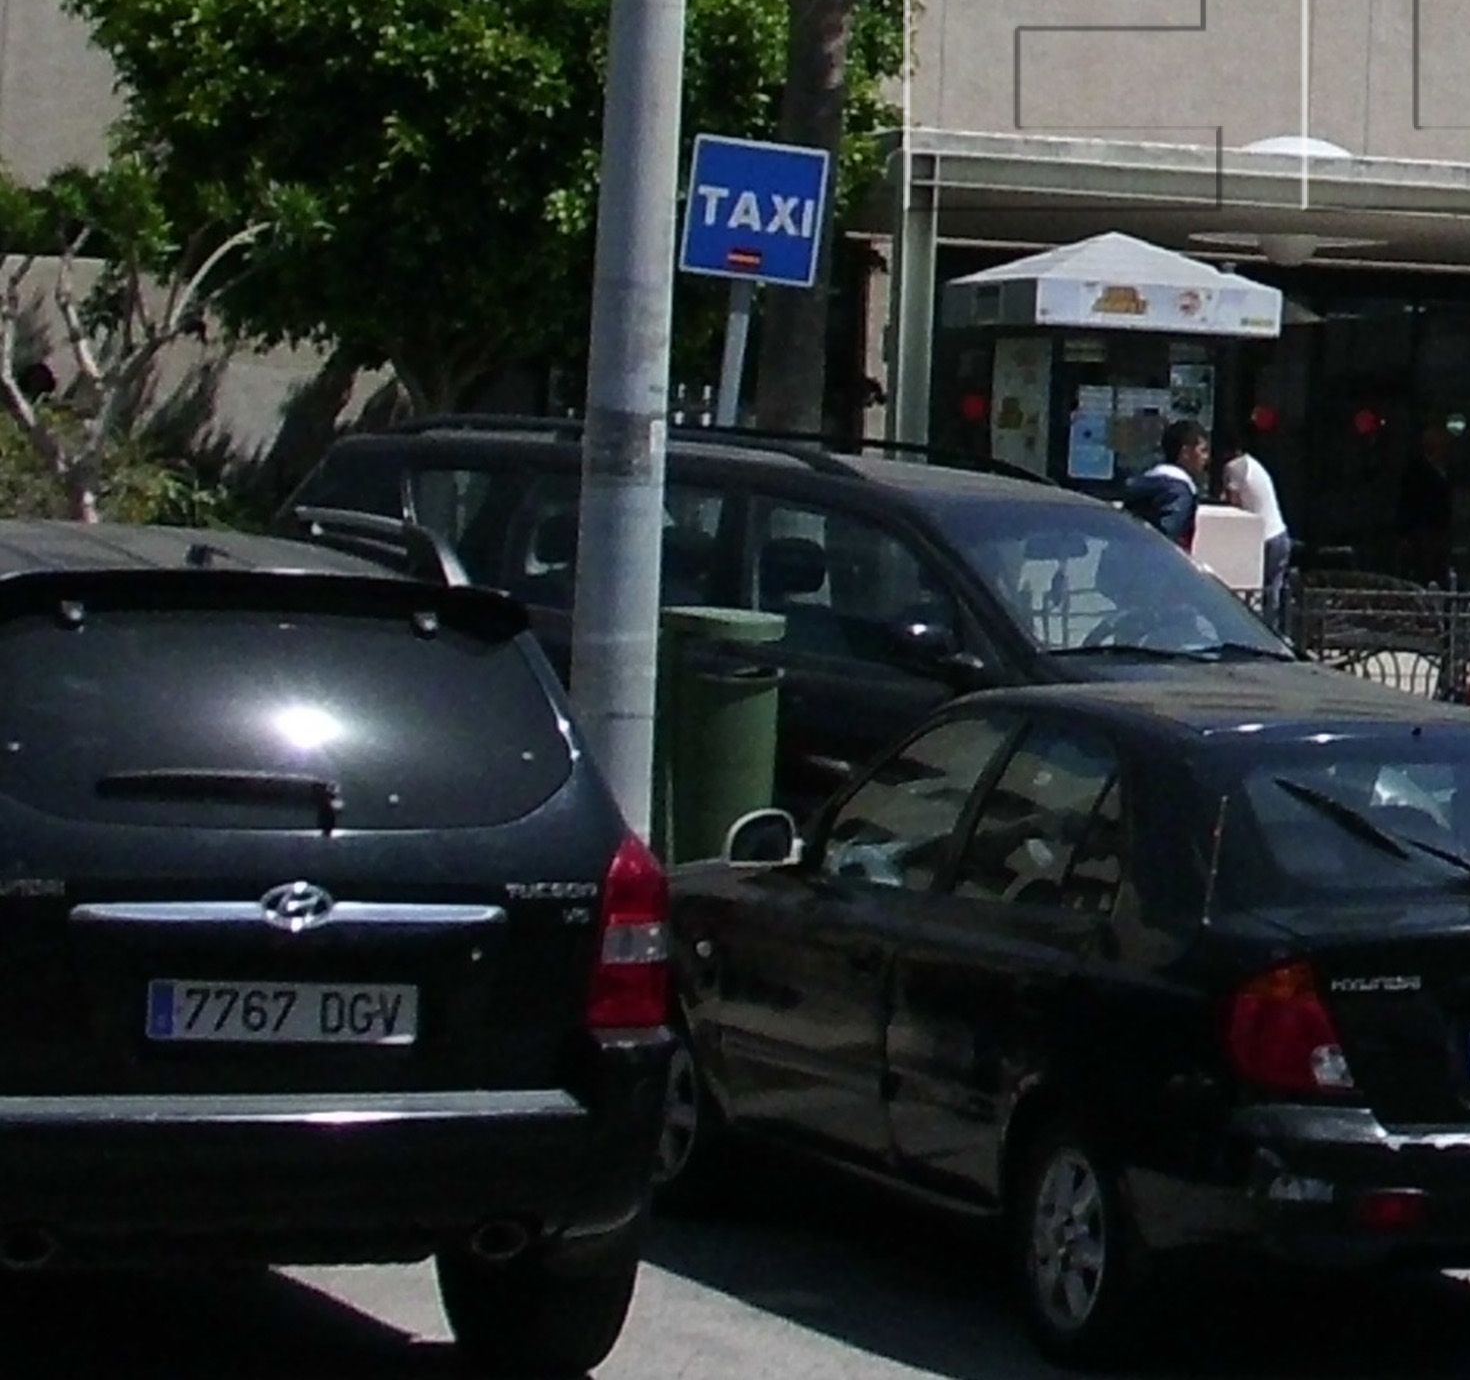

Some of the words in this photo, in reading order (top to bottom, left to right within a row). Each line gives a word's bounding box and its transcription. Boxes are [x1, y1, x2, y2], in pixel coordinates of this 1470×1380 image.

[698, 184, 815, 238] TAXI
[184, 987, 297, 1033] 7767
[319, 991, 403, 1036] DGV
